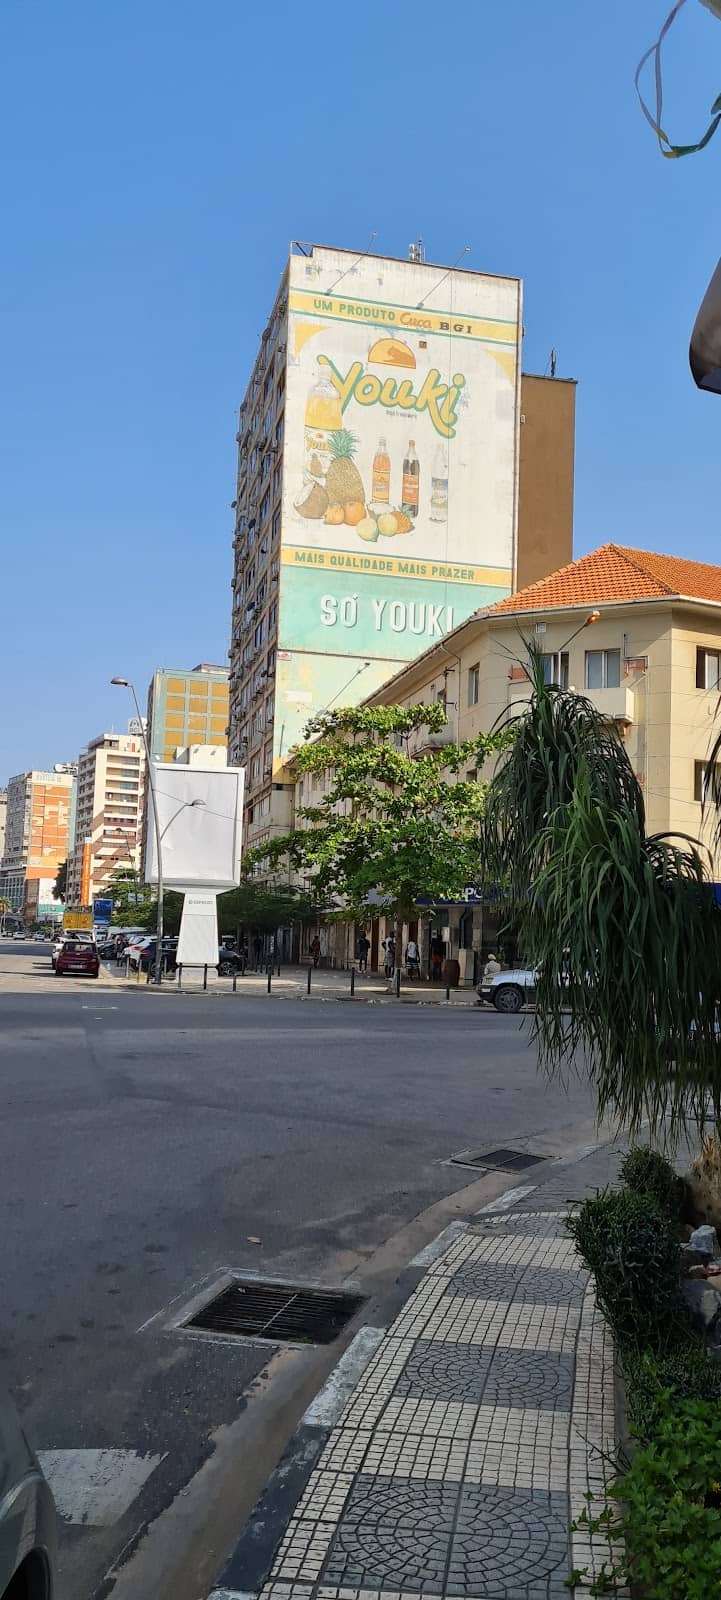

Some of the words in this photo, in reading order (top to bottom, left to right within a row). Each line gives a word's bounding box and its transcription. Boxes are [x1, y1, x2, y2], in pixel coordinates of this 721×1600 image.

[313, 299, 333, 312] UM
[339, 303, 396, 321] PRODUTO
[399, 312, 433, 329] Cuca
[316, 354, 466, 439] Youki
[294, 551, 325, 565] MAIS
[329, 555, 393, 572] QUALIDADE
[398, 562, 427, 575] MAIS
[431, 566, 475, 580] PRAZER
[319, 592, 359, 629] SÓ
[372, 599, 454, 637] YOUKI
